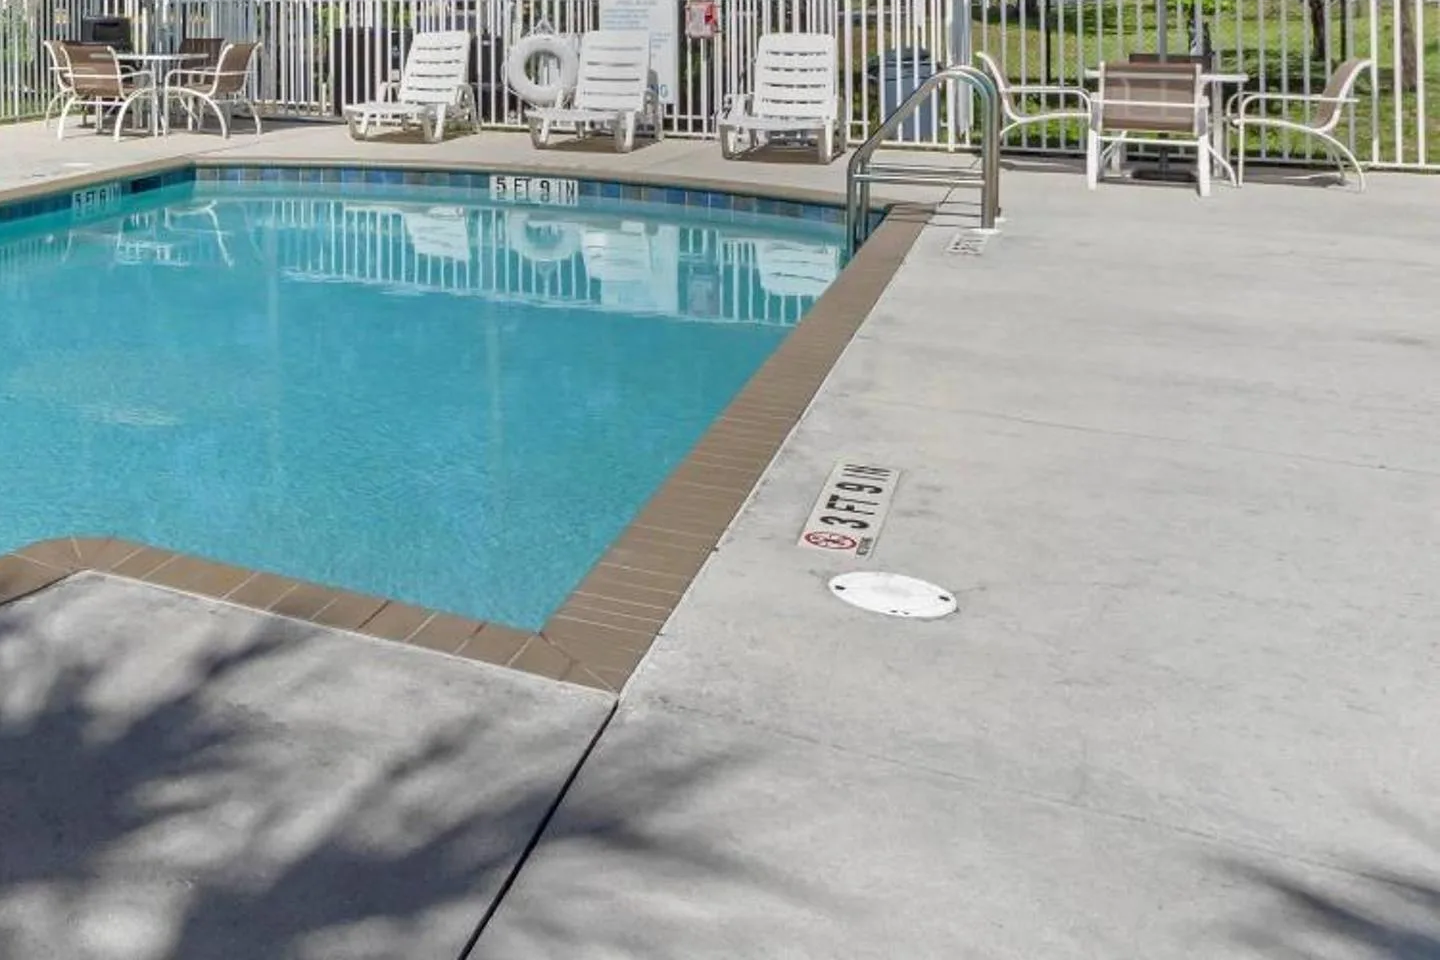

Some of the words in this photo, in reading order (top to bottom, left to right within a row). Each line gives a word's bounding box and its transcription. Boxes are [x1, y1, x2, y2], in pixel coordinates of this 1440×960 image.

[514, 178, 532, 196] FT
[558, 180, 575, 200] IN
[841, 463, 892, 482] IN
[835, 481, 883, 495] 9
[825, 493, 880, 515] FT
[819, 515, 869, 529] 3
